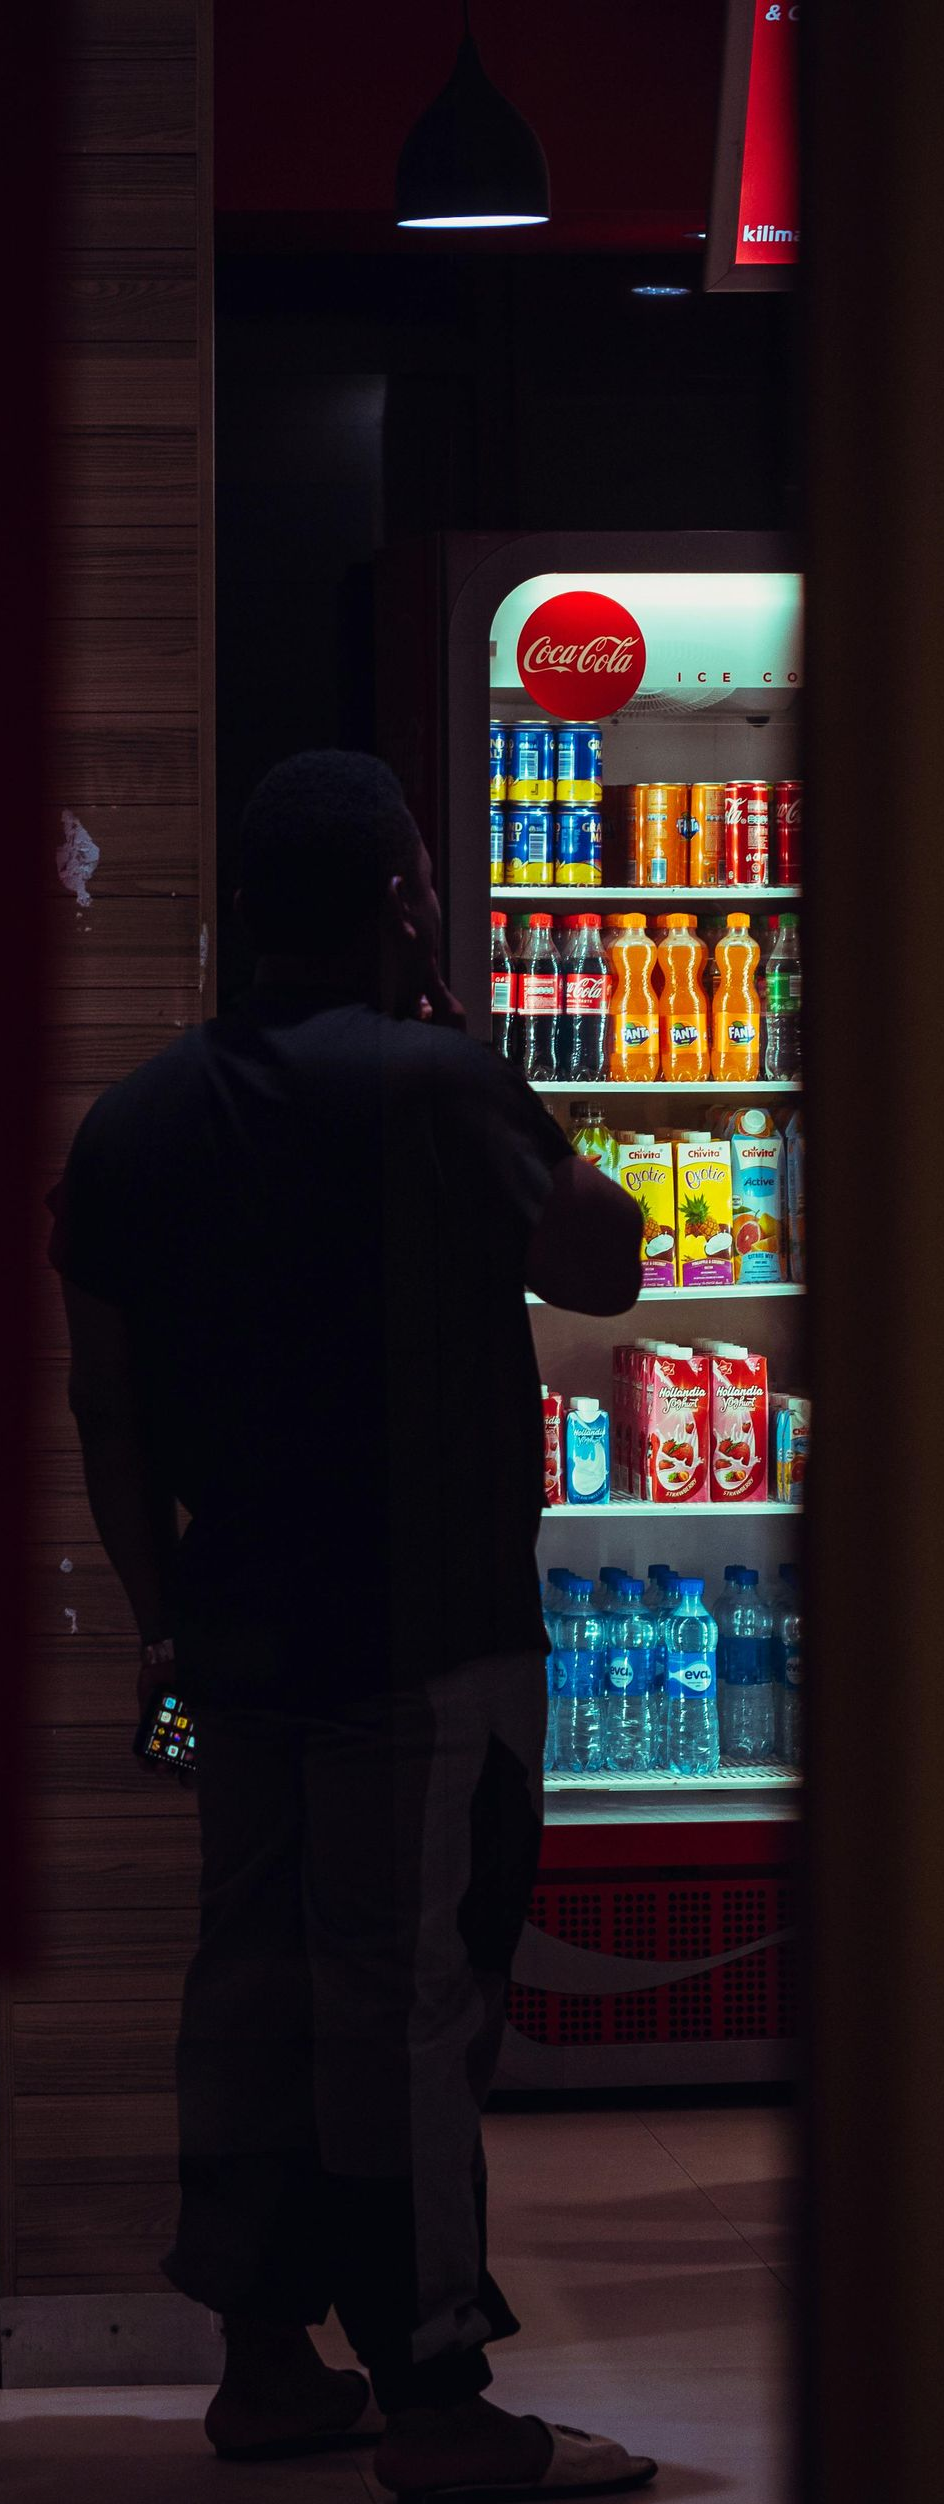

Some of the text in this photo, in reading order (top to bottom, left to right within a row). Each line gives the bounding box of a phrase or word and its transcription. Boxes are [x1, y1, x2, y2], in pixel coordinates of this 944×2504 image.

[765, 4, 781, 21] &
[523, 635, 640, 674] Coca-Cola
[677, 671, 731, 683] ICE
[621, 1026, 650, 1041] FANTA
[670, 1026, 699, 1041] FANTA
[628, 1150, 661, 1160] Chivita
[687, 1149, 720, 1158] Chivita
[742, 1149, 775, 1158] Chivita
[744, 1176, 775, 1186] Active
[658, 1385, 707, 1398] Hollandia
[716, 1385, 764, 1397] Hollandia
